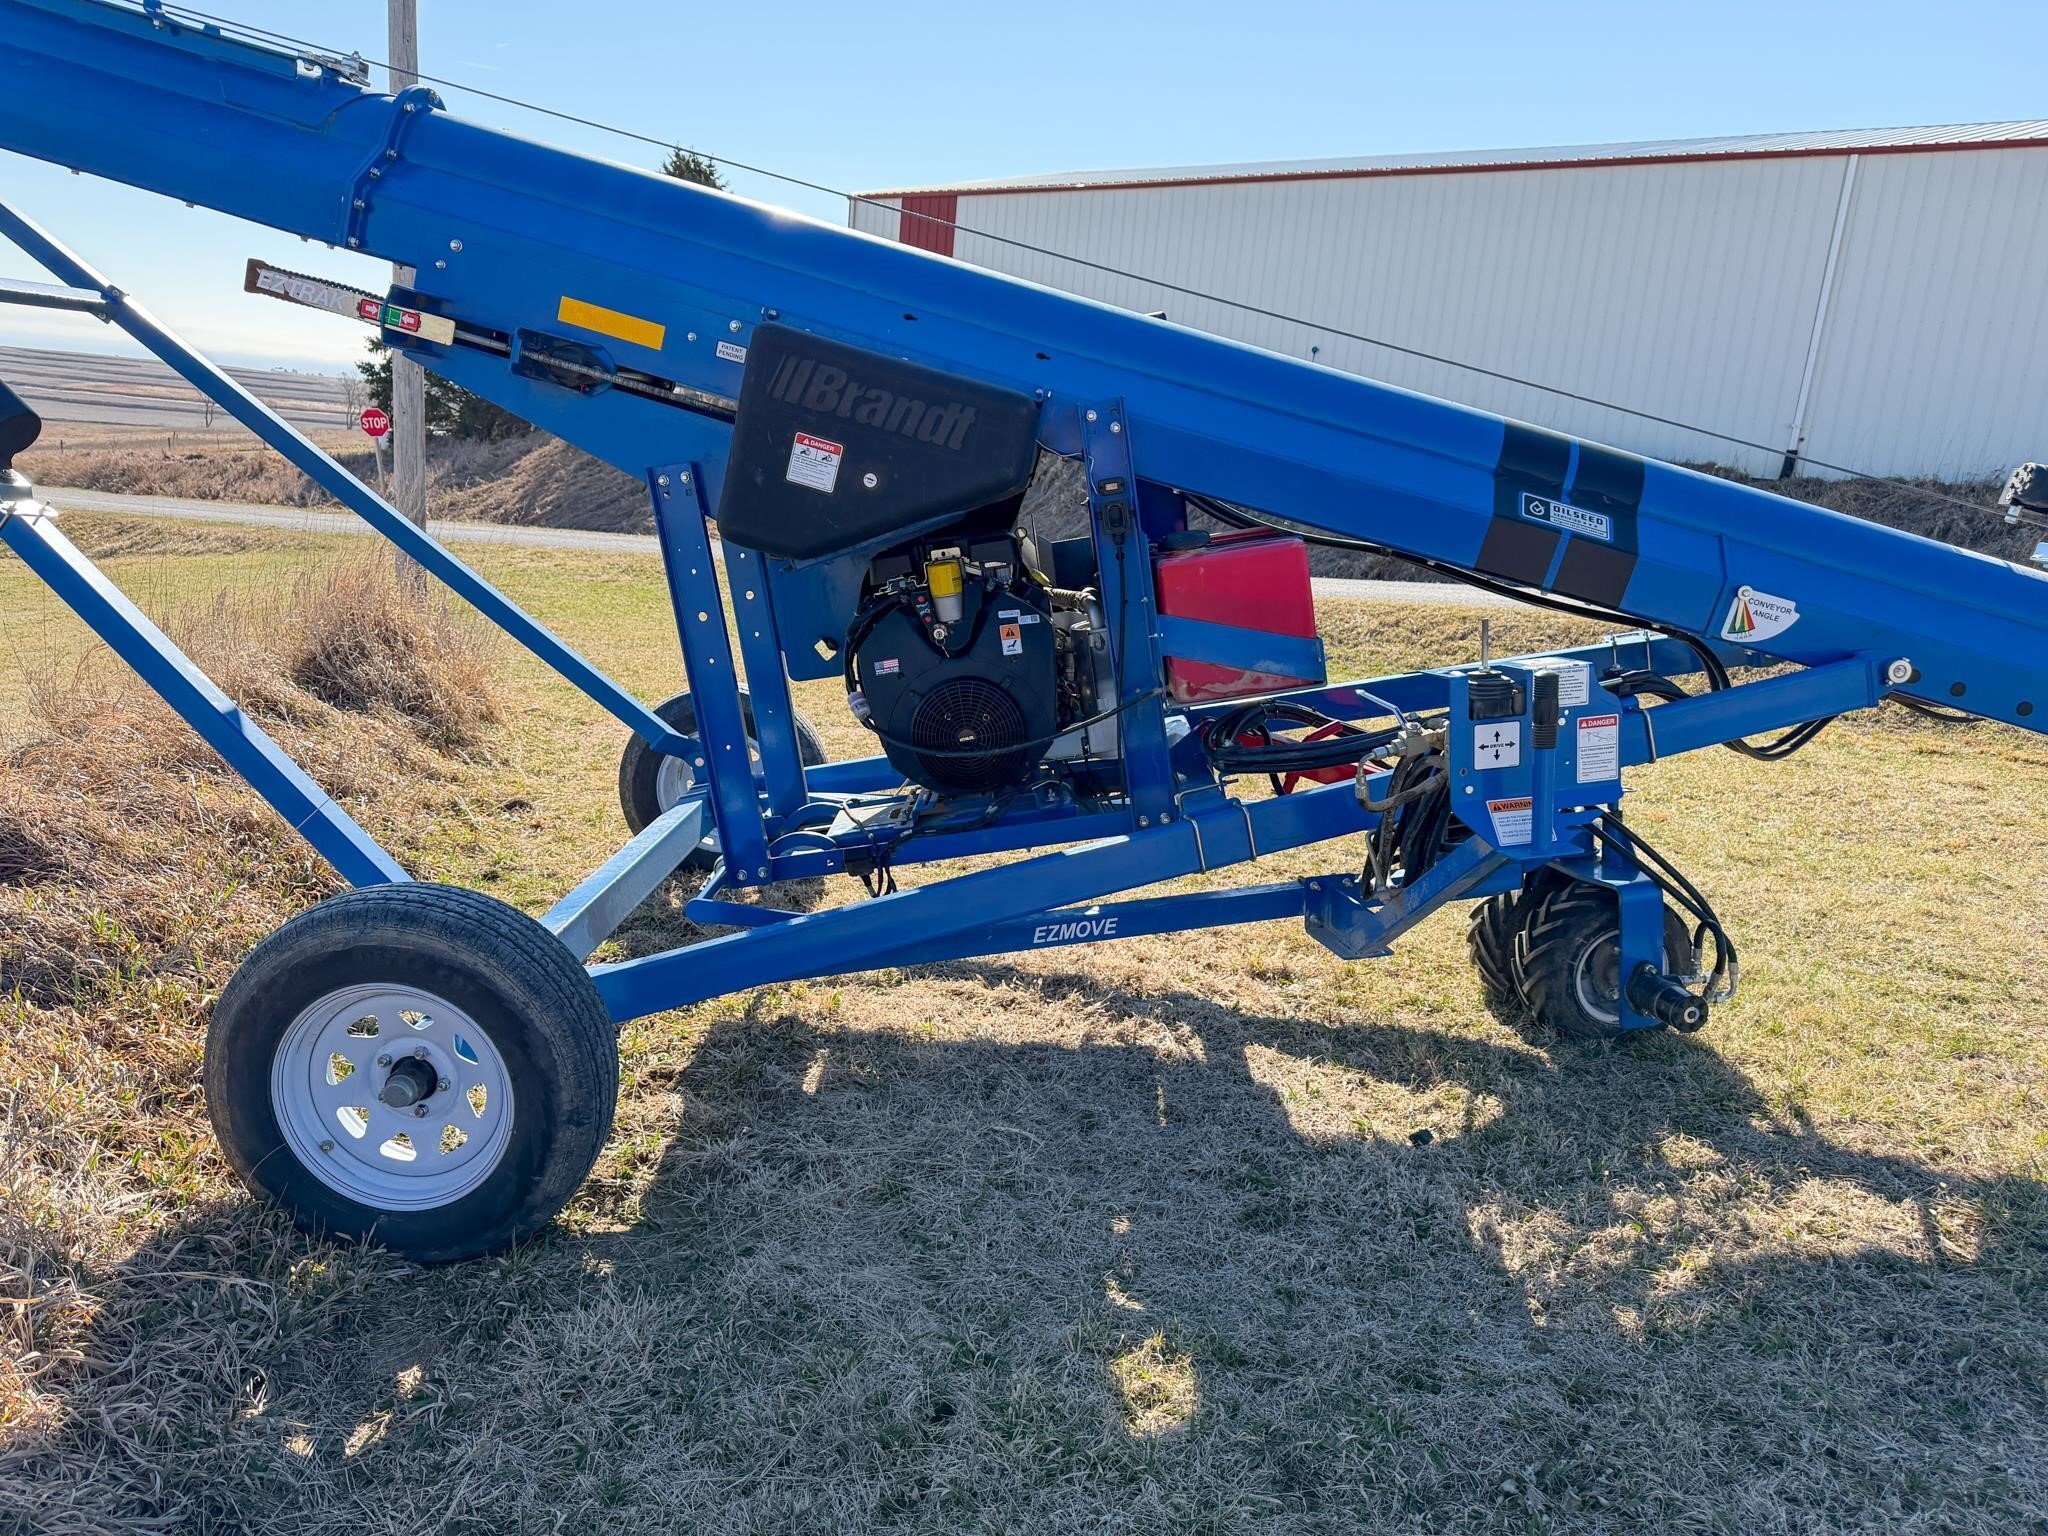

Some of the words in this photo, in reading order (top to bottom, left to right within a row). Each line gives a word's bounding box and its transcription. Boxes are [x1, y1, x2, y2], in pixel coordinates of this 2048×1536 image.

[256, 268, 345, 310] EZTRAK
[718, 349, 743, 360] PENDING
[721, 343, 743, 354] PATENT
[802, 363, 978, 450] Brandt
[361, 416, 387, 430] STOP
[810, 440, 835, 452] DANGER
[1553, 505, 1604, 526] OILSEED
[1748, 598, 1793, 615] CONVEYOR
[1752, 609, 1780, 622] ANGLE
[1588, 718, 1616, 727] DANGER
[1500, 801, 1532, 810] WARNIN
[1033, 918, 1119, 944] EZMOVE
